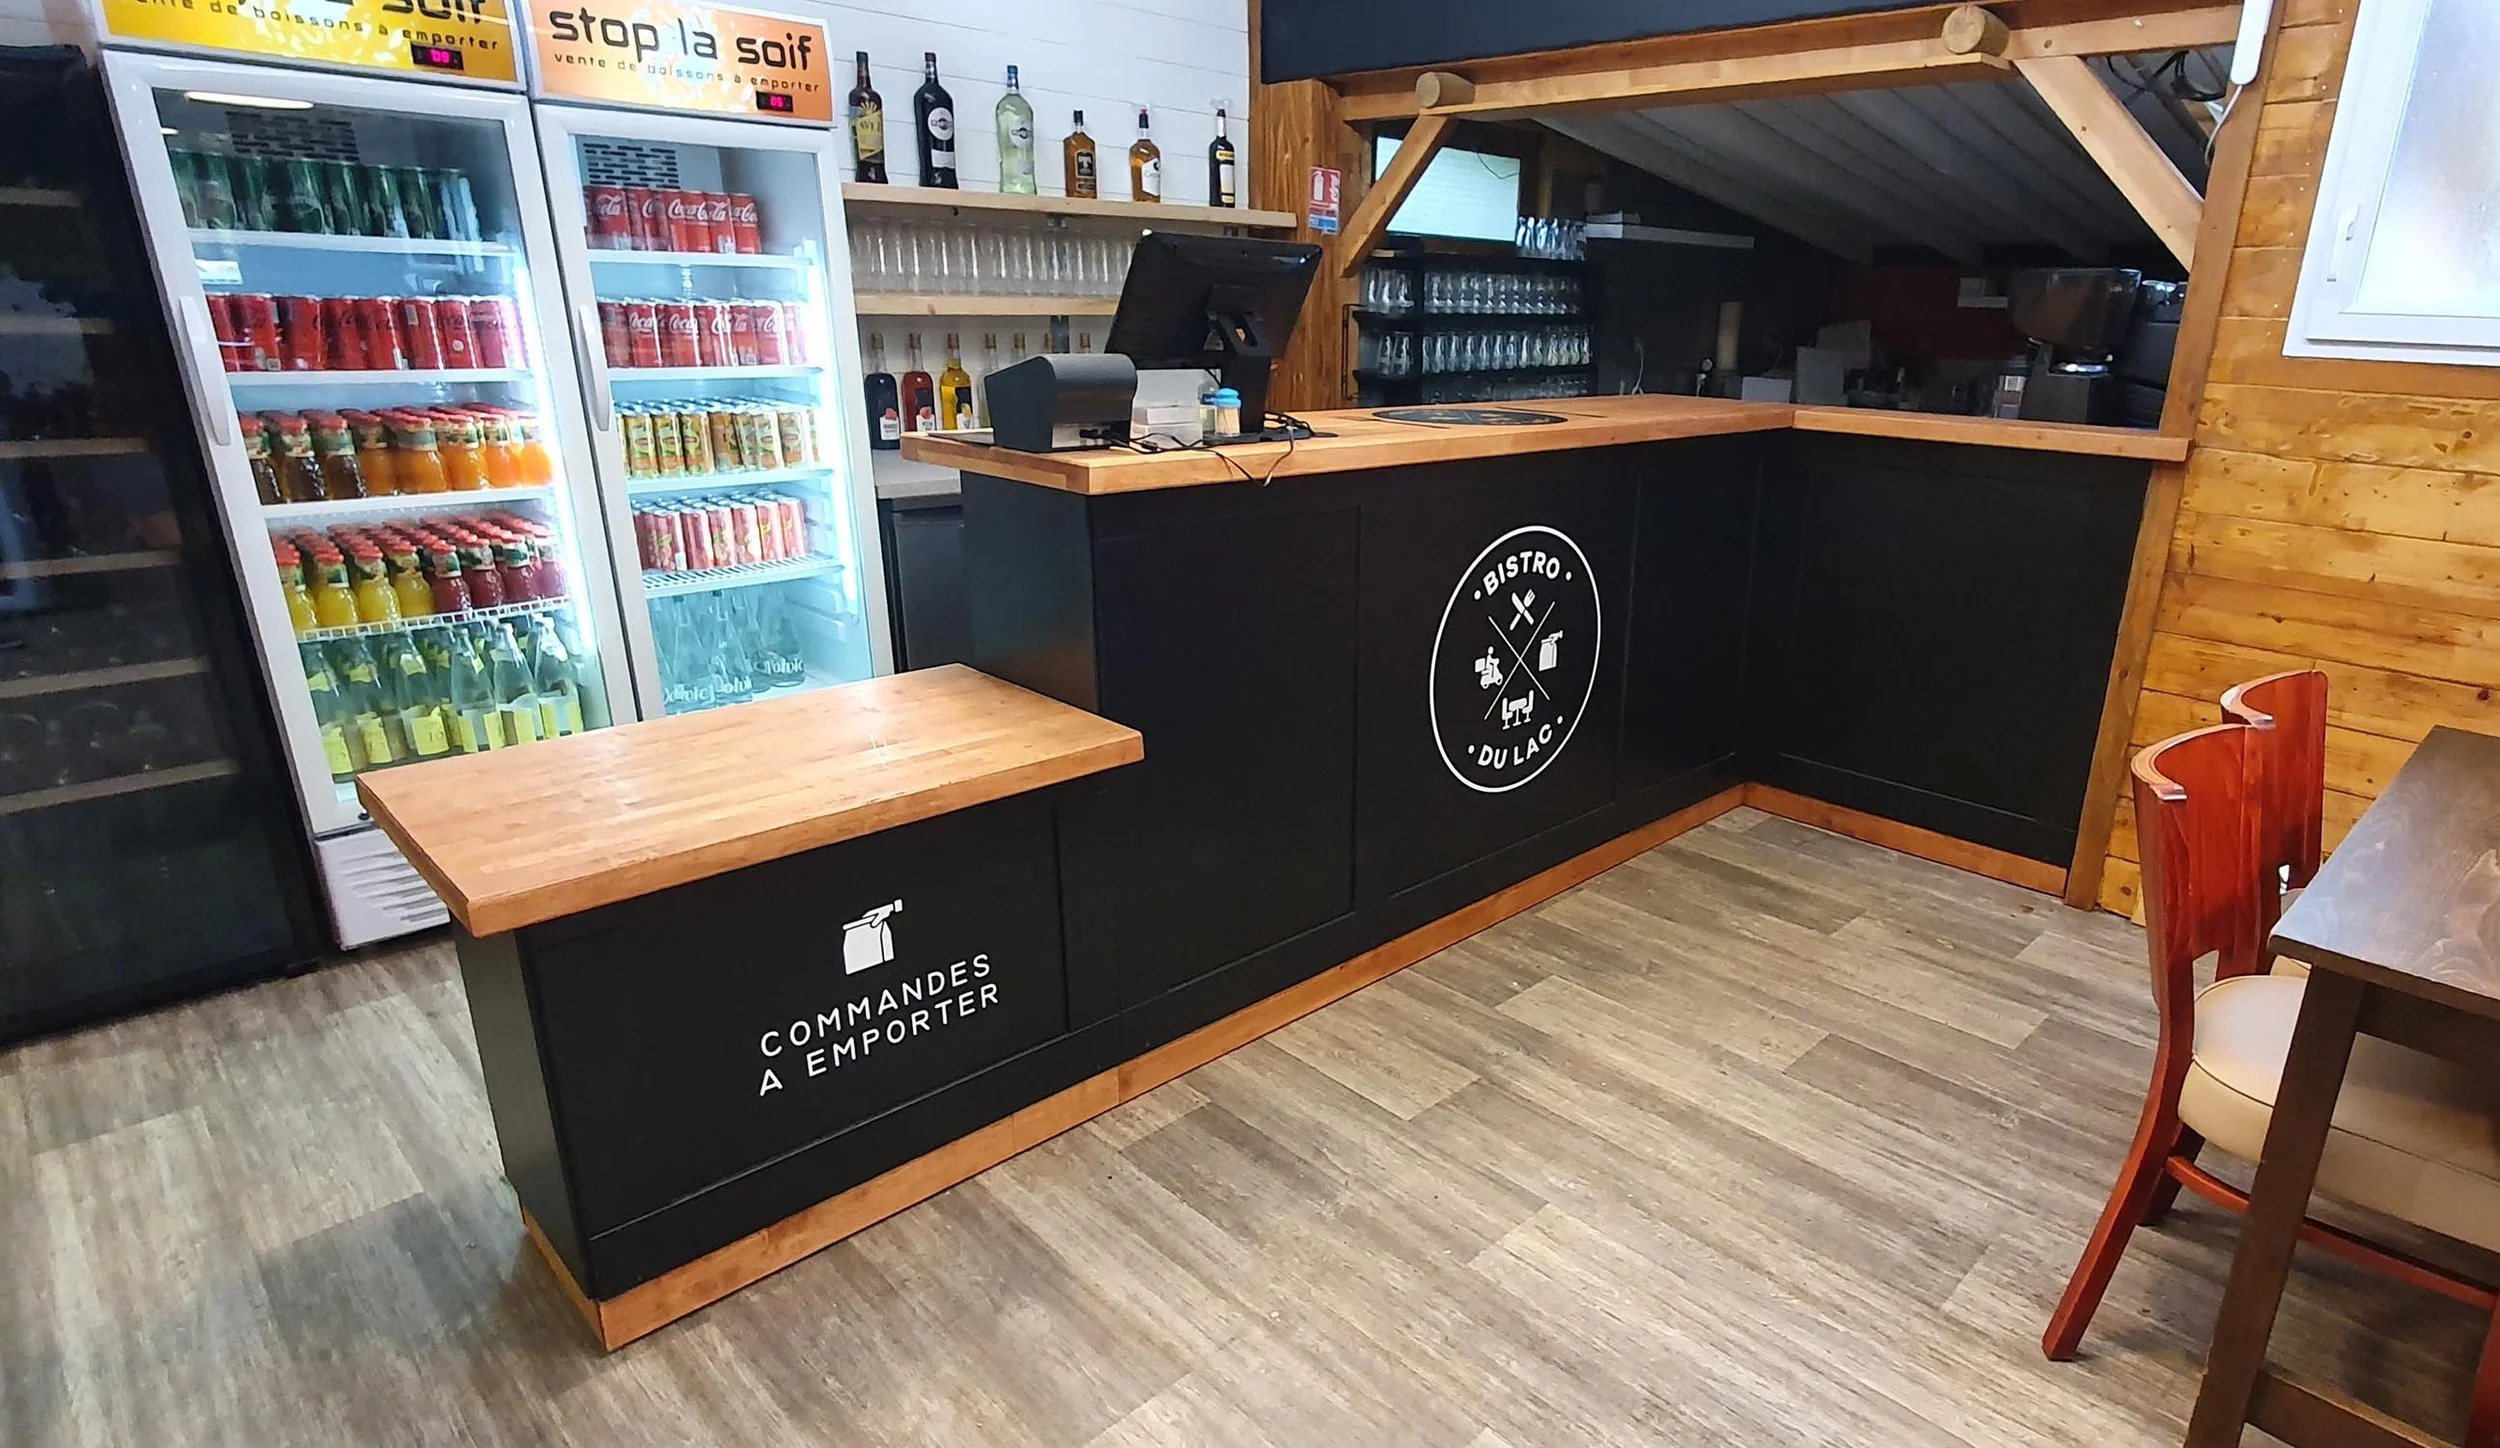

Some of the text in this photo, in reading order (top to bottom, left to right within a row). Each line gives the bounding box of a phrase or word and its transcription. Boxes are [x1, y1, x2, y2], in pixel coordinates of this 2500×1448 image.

[210, 1, 238, 15] de
[253, 5, 363, 32] boissons
[402, 29, 498, 50] emporter
[550, 7, 813, 71] stop la soif
[554, 53, 607, 69] vente
[617, 60, 637, 72] de
[647, 64, 724, 82] boissons
[750, 77, 820, 93] emporter
[1483, 550, 1560, 596] BISTRO
[1477, 723, 1553, 770] DU LAC
[760, 954, 990, 1058] COMMANDES
[759, 983, 999, 1097] A EMPORTER
